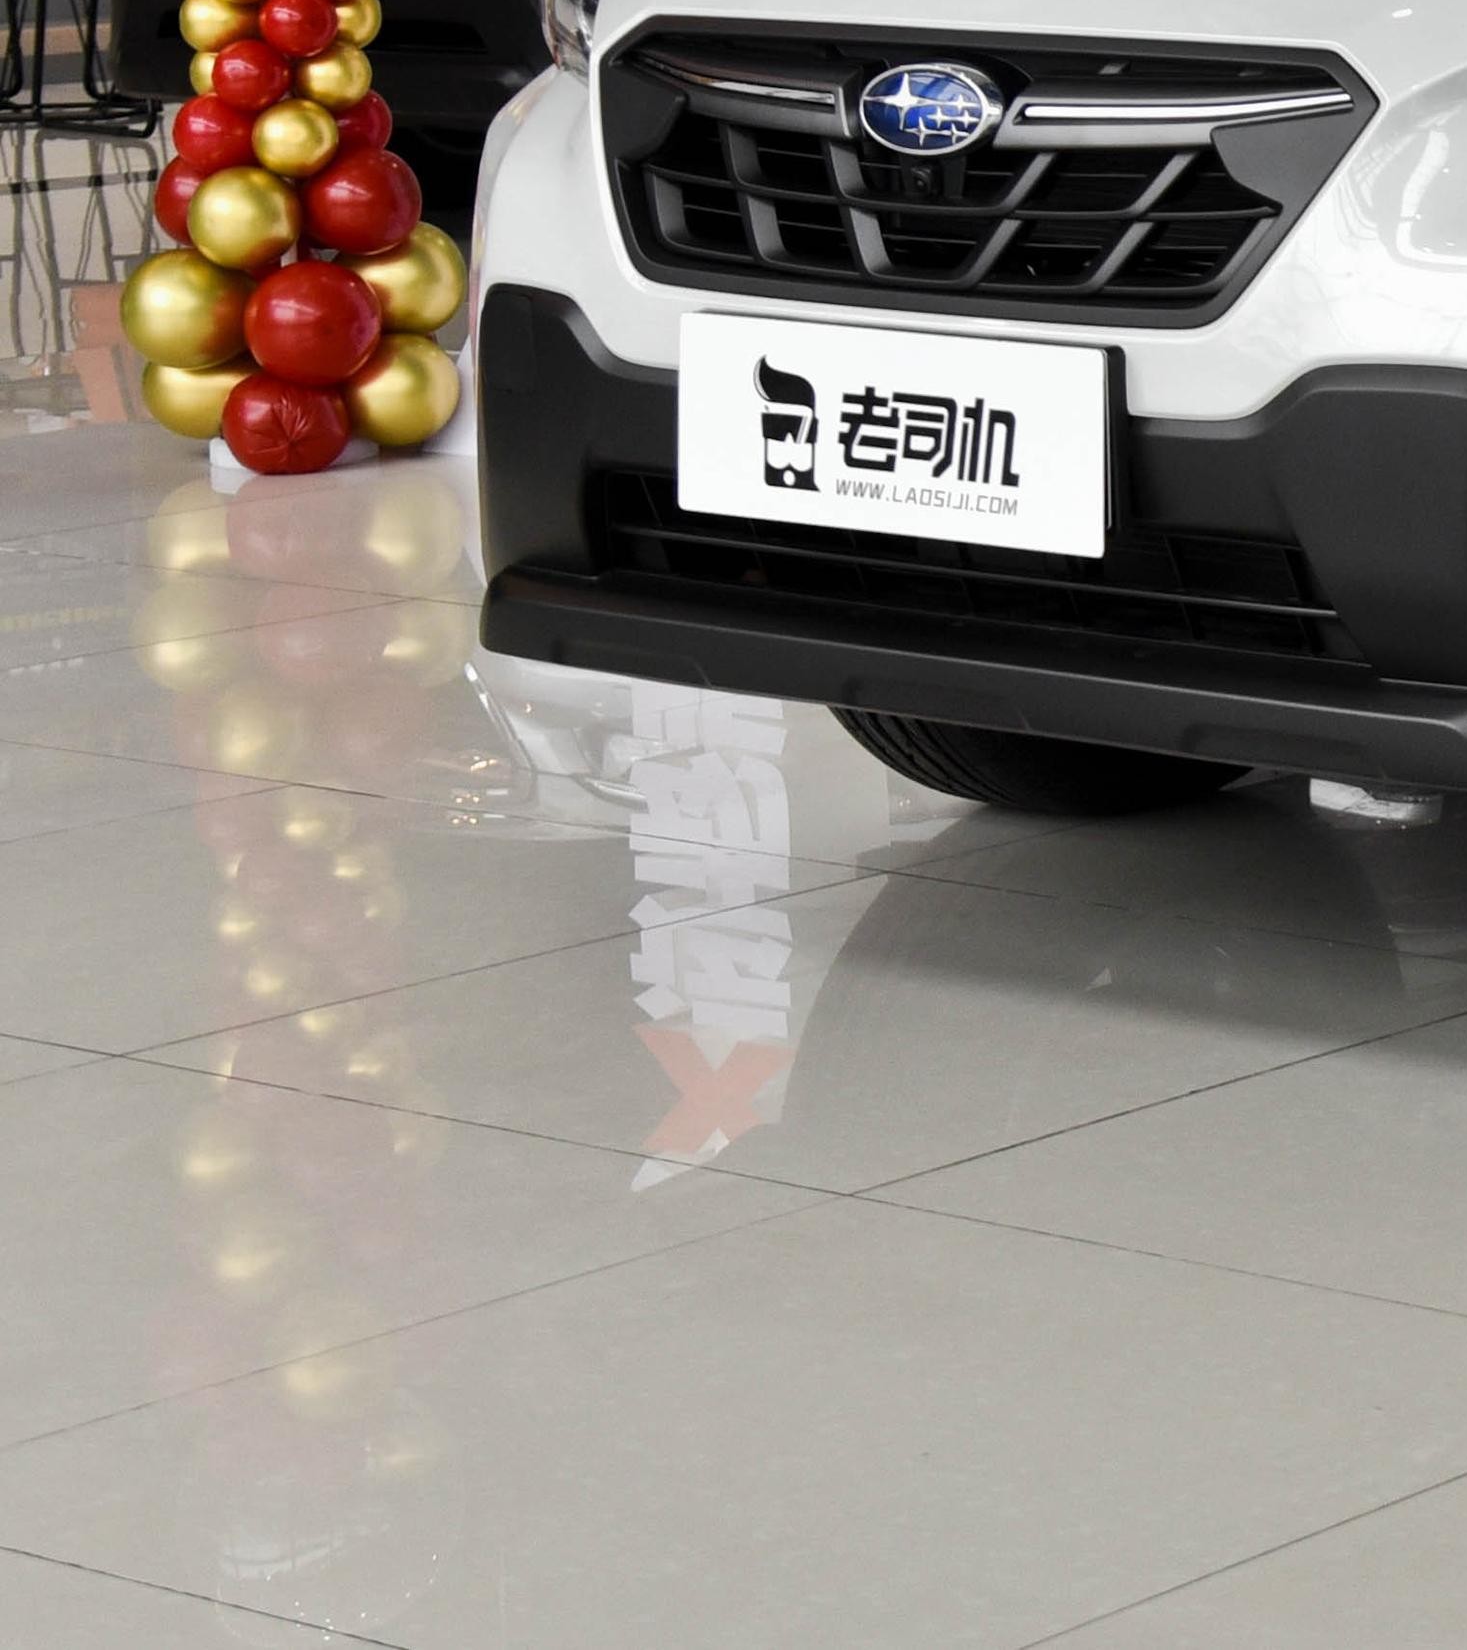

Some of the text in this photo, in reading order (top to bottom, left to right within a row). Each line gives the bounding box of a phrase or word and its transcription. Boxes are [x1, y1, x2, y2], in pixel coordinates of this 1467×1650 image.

[837, 386, 1020, 487] 老司机
[835, 479, 1019, 517] WWW.LAOSIJI.COM
